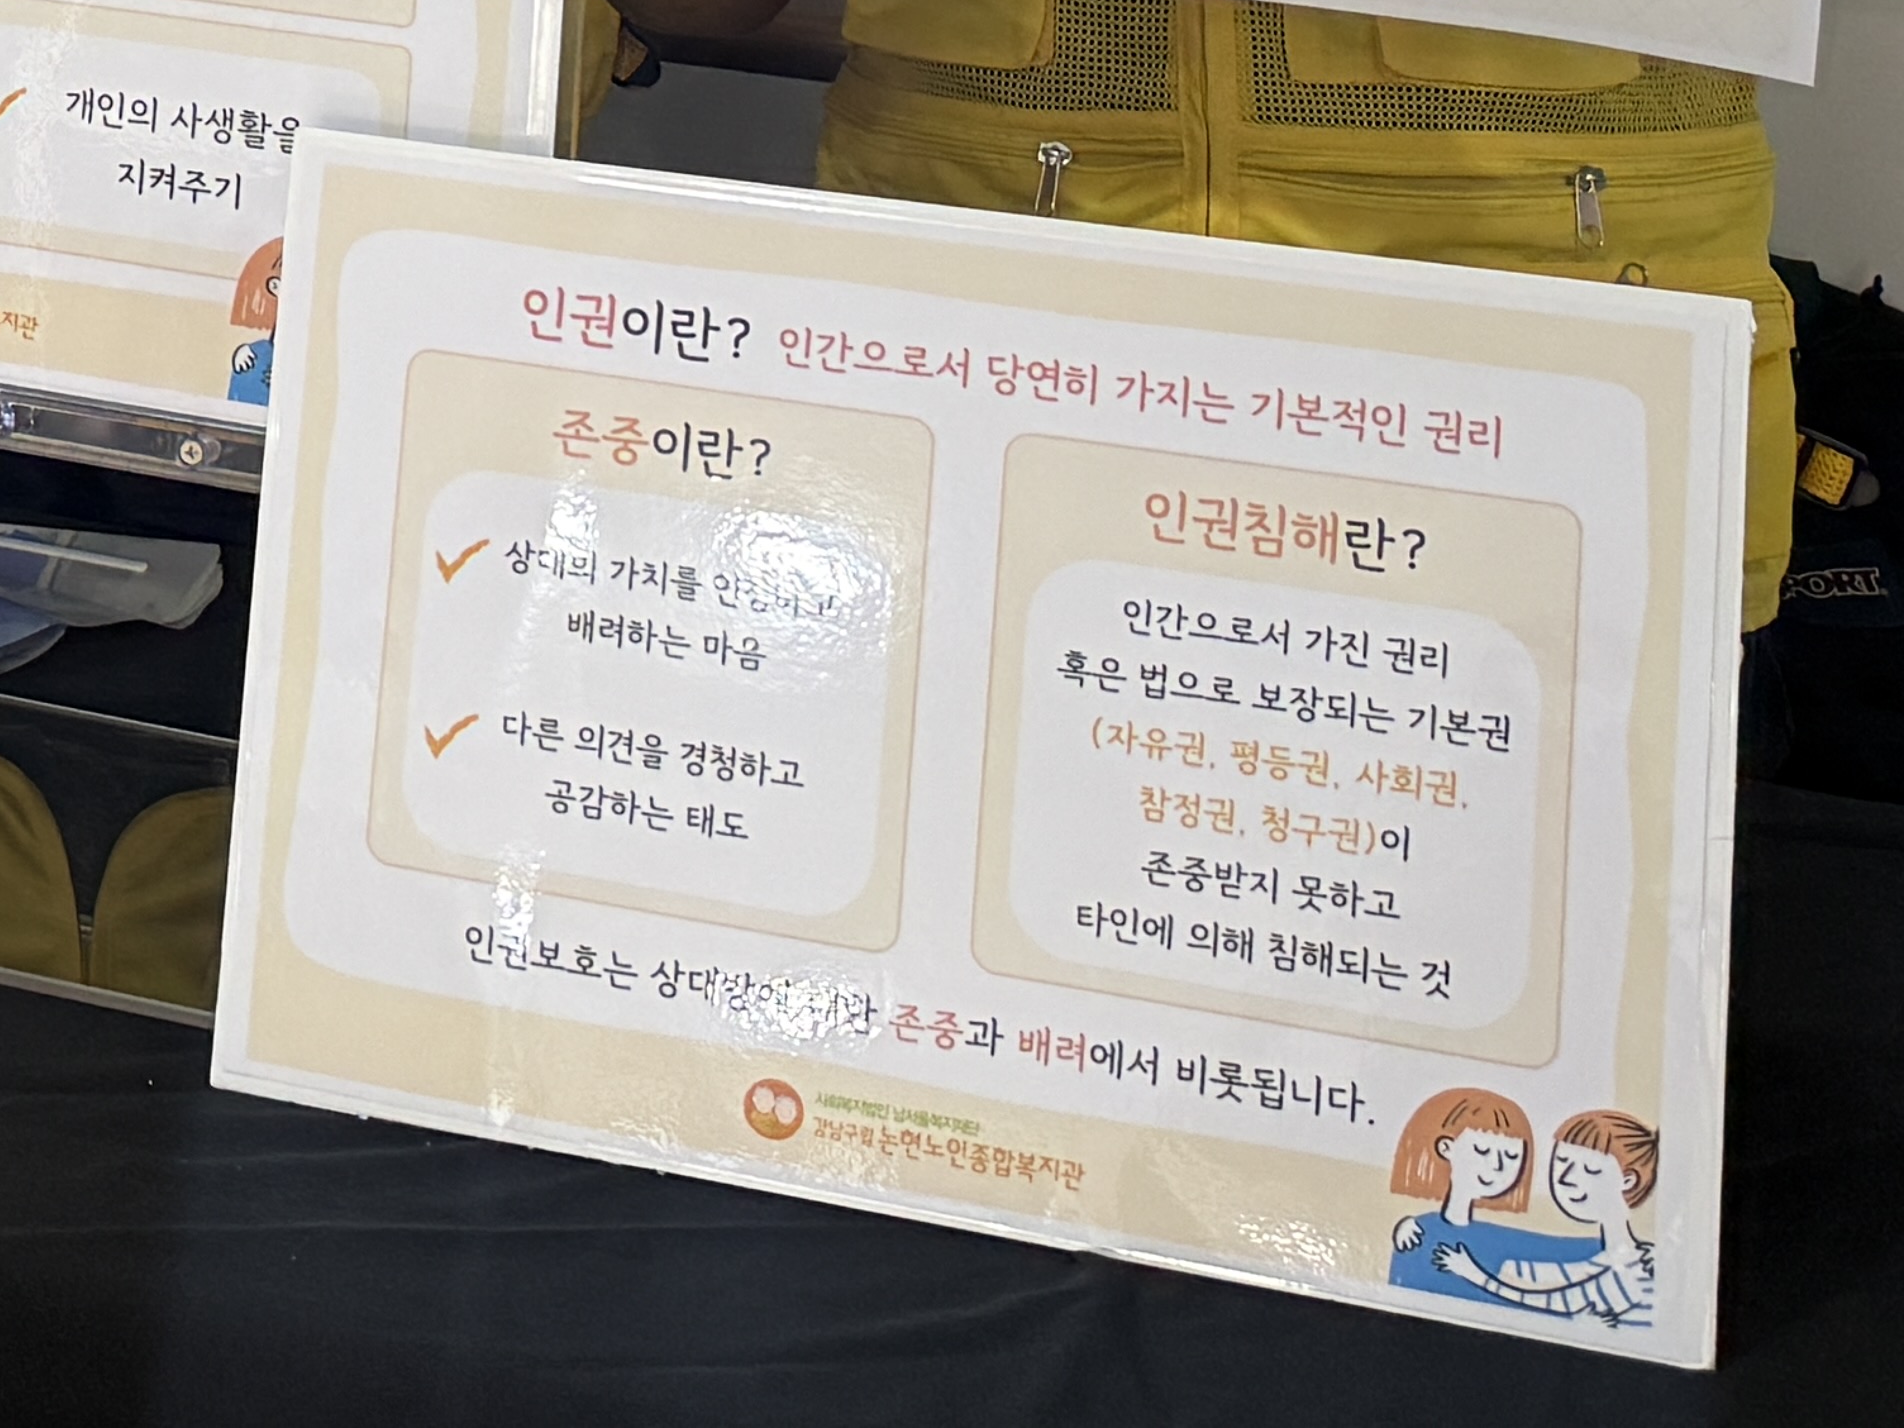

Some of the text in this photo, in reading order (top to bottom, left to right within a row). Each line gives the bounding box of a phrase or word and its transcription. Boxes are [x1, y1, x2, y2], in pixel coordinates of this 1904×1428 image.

[67, 88, 299, 154] 개인의 사생활을
[119, 159, 240, 209] 지켜주기
[525, 288, 1501, 459] 인권이란? 인간으로서 당연히 가지는 기본적인 권리
[554, 411, 770, 479] 존중이란?
[1146, 492, 1425, 572] 인권침해란?
[505, 540, 596, 585] 상대의
[611, 556, 702, 601] 가치를
[568, 610, 766, 671] 배려하는 마음
[1124, 599, 1447, 678] 인간으로서 가진 권리
[1057, 650, 1509, 752] 혹은 법으로 보장되는 기본권
[503, 711, 804, 787] 다른 의견을 경청하고
[1093, 717, 1467, 809] (자유권, 평등권, 사회권,
[545, 780, 748, 839] 공감하는 태도
[1140, 786, 1410, 862] 참정권, 청구권)이
[1141, 851, 1400, 919] 존중받지 못하고
[466, 926, 638, 990] 인권보호는
[1078, 902, 1450, 999] 타인에 의해 침해되는 것
[889, 1005, 1004, 1057] 존중과
[1020, 1027, 1158, 1086] 배려에서
[1177, 1055, 1374, 1125] 비롯됩니다.
[879, 1124, 1084, 1190] 논현노인종합복지관
